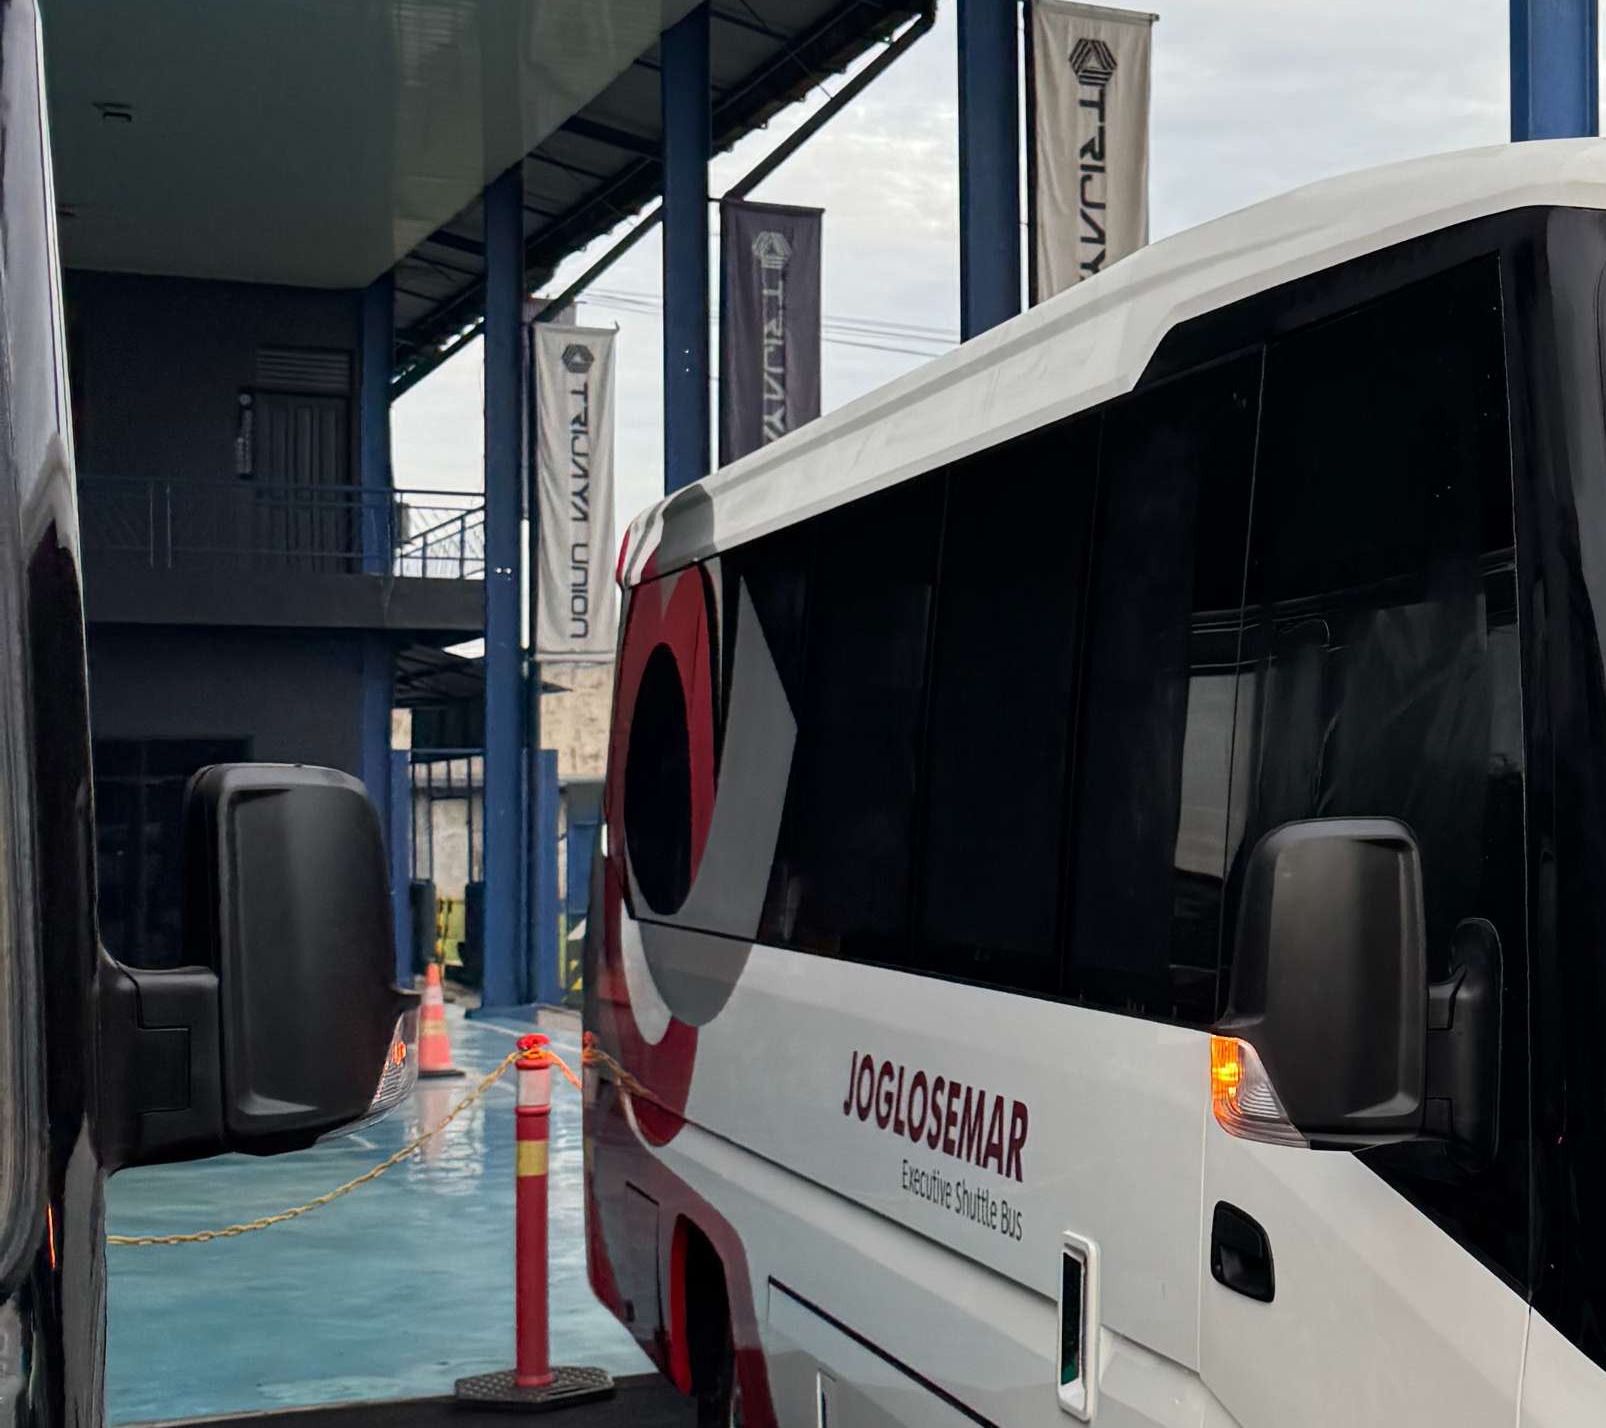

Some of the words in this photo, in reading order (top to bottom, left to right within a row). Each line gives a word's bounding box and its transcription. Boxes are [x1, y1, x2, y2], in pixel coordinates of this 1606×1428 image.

[1079, 87, 1107, 281] TRIJAY
[569, 381, 591, 523] TRIJAYA
[843, 1050, 1029, 1183] JOGLOSEMAR
[901, 1158, 953, 1211] Executive
[955, 1178, 998, 1231] Shuttle
[1000, 1199, 1024, 1242] Bus
